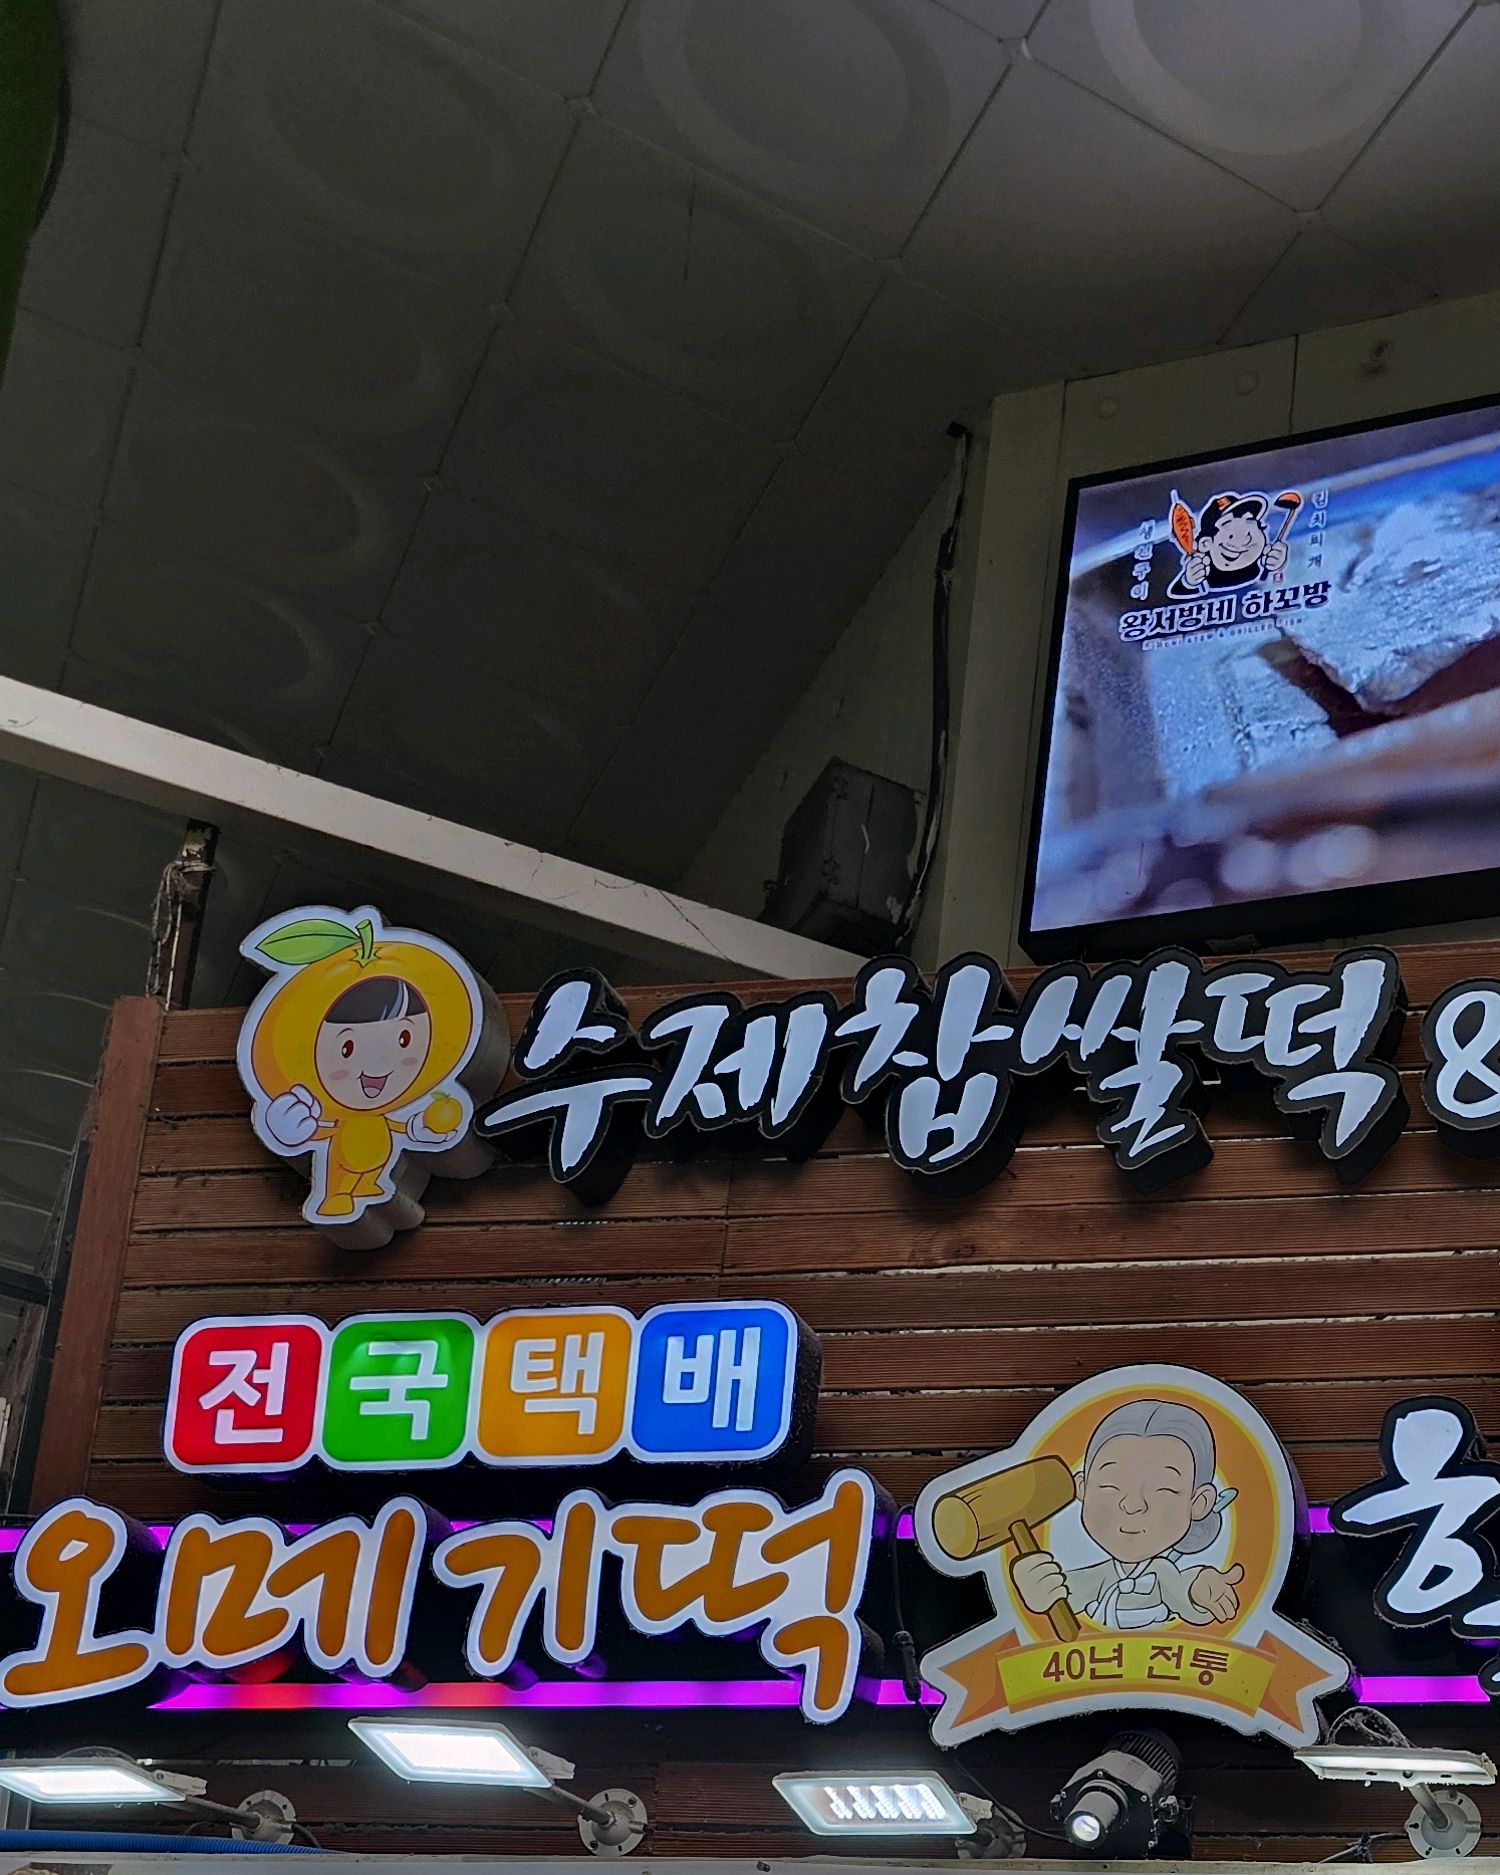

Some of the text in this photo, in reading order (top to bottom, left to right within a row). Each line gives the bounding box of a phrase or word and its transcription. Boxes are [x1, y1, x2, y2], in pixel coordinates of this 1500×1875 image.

[1120, 581, 1332, 641] 왕서방네 하꼬방
[476, 960, 1390, 1172] 수제찹쌀떡
[3, 1481, 865, 1713] 오메기떡
[1042, 1643, 1229, 1686] 40년 전통
